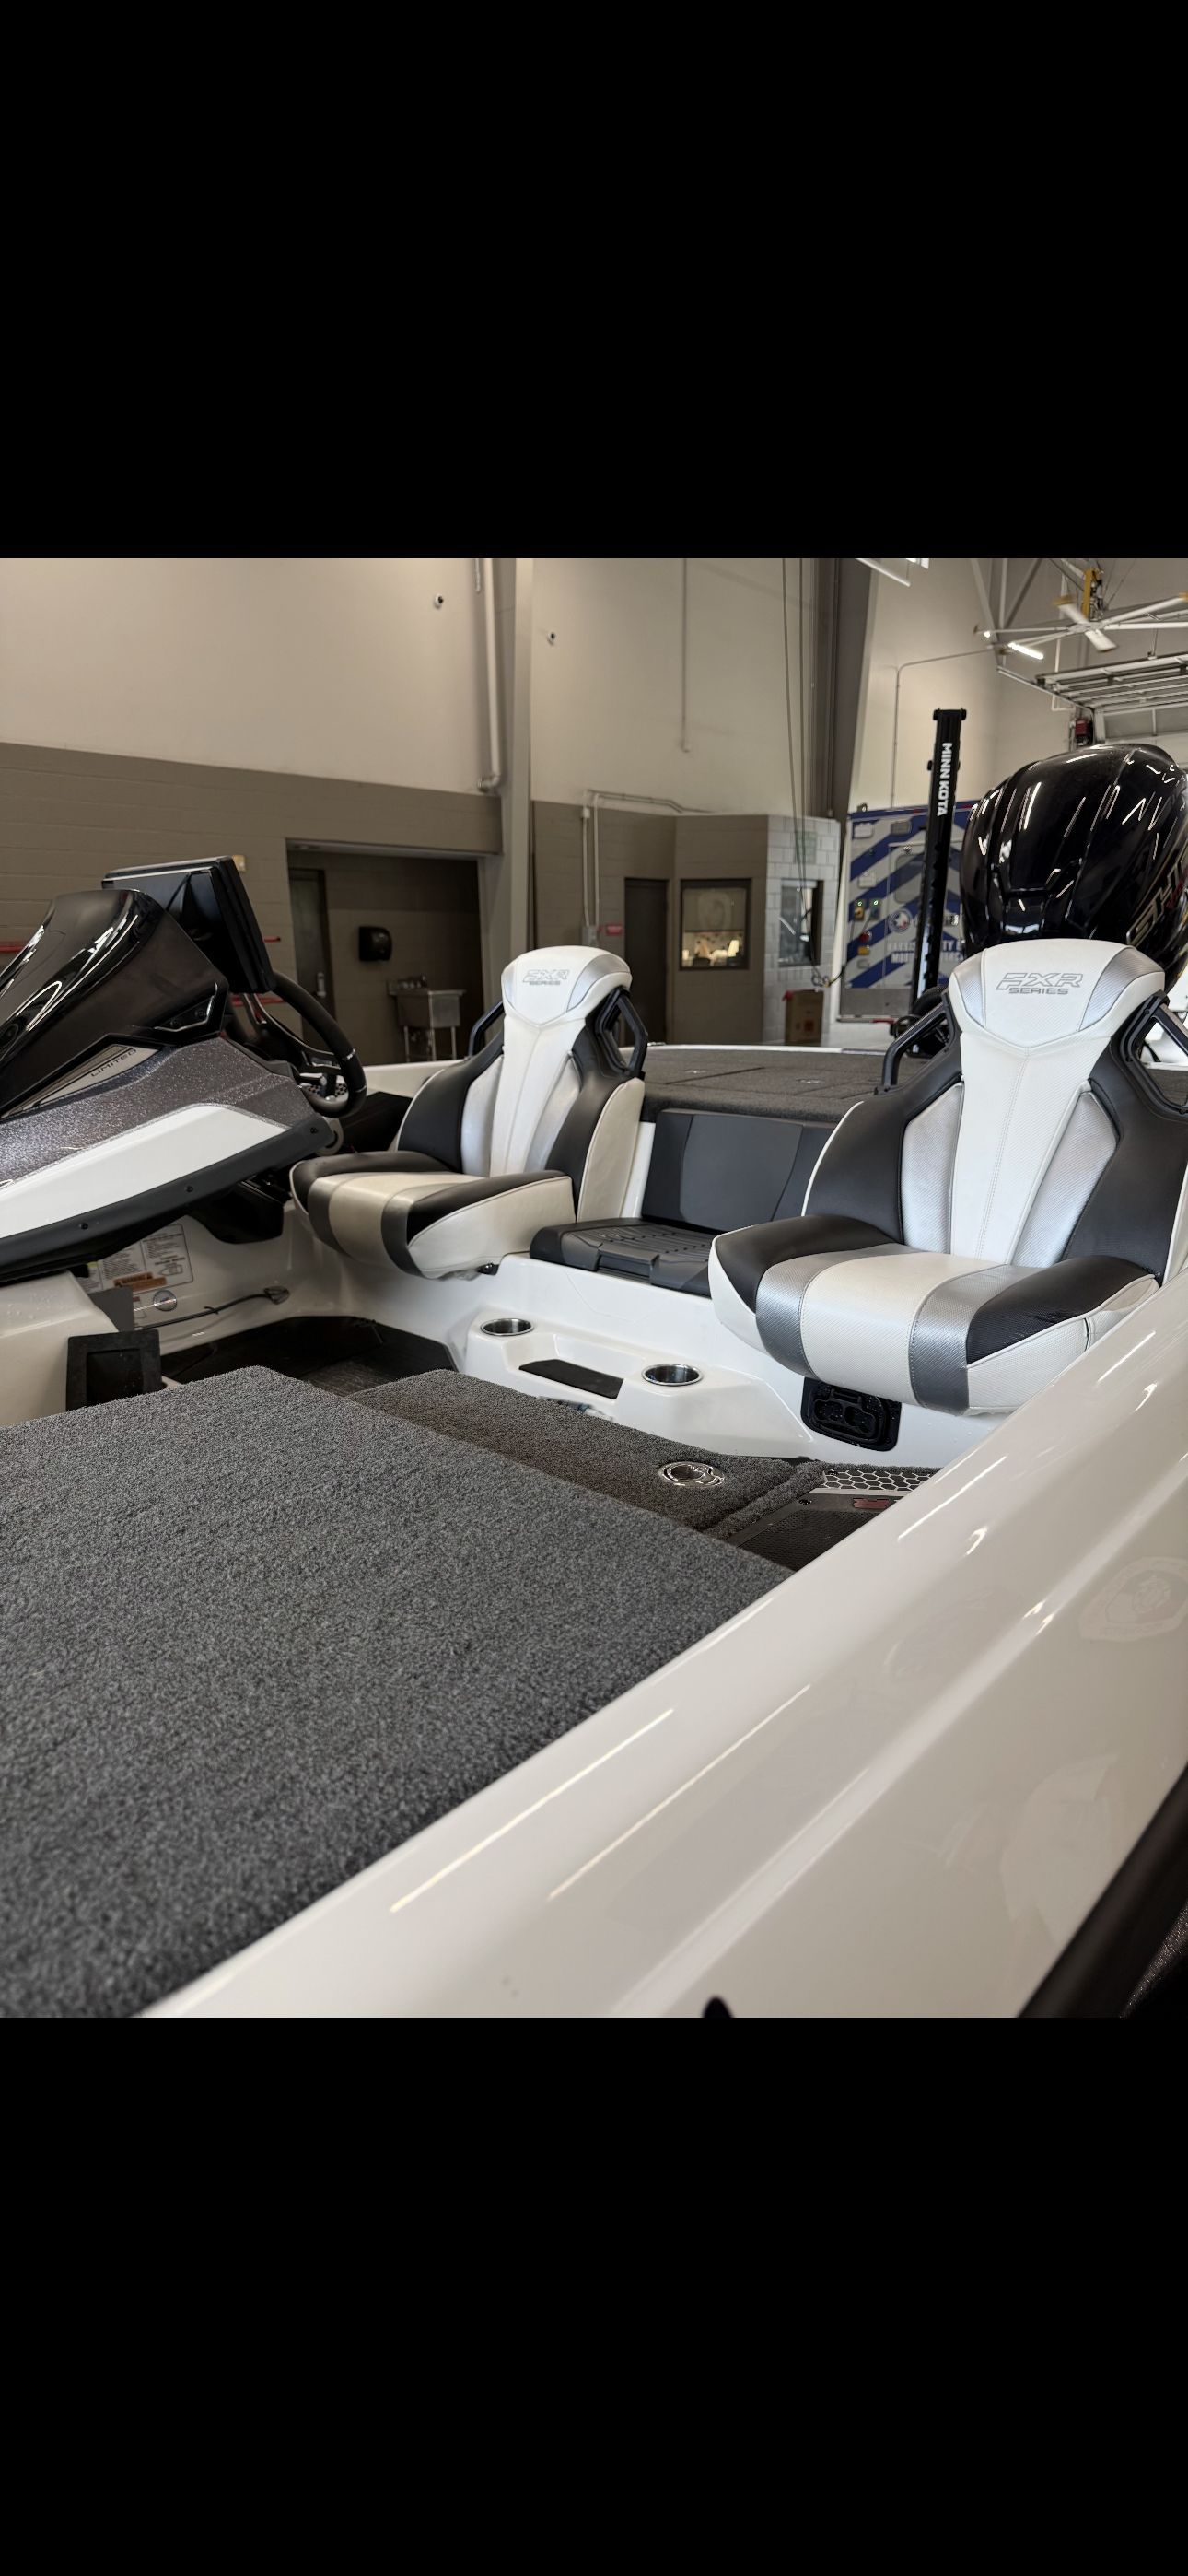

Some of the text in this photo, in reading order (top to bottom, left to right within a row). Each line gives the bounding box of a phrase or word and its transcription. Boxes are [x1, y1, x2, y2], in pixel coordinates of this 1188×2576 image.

[937, 742, 953, 817] MINN KOTA
[996, 972, 1083, 990] FXR
[1008, 987, 1069, 995] SERIES
[91, 1047, 137, 1077] LIMITED
